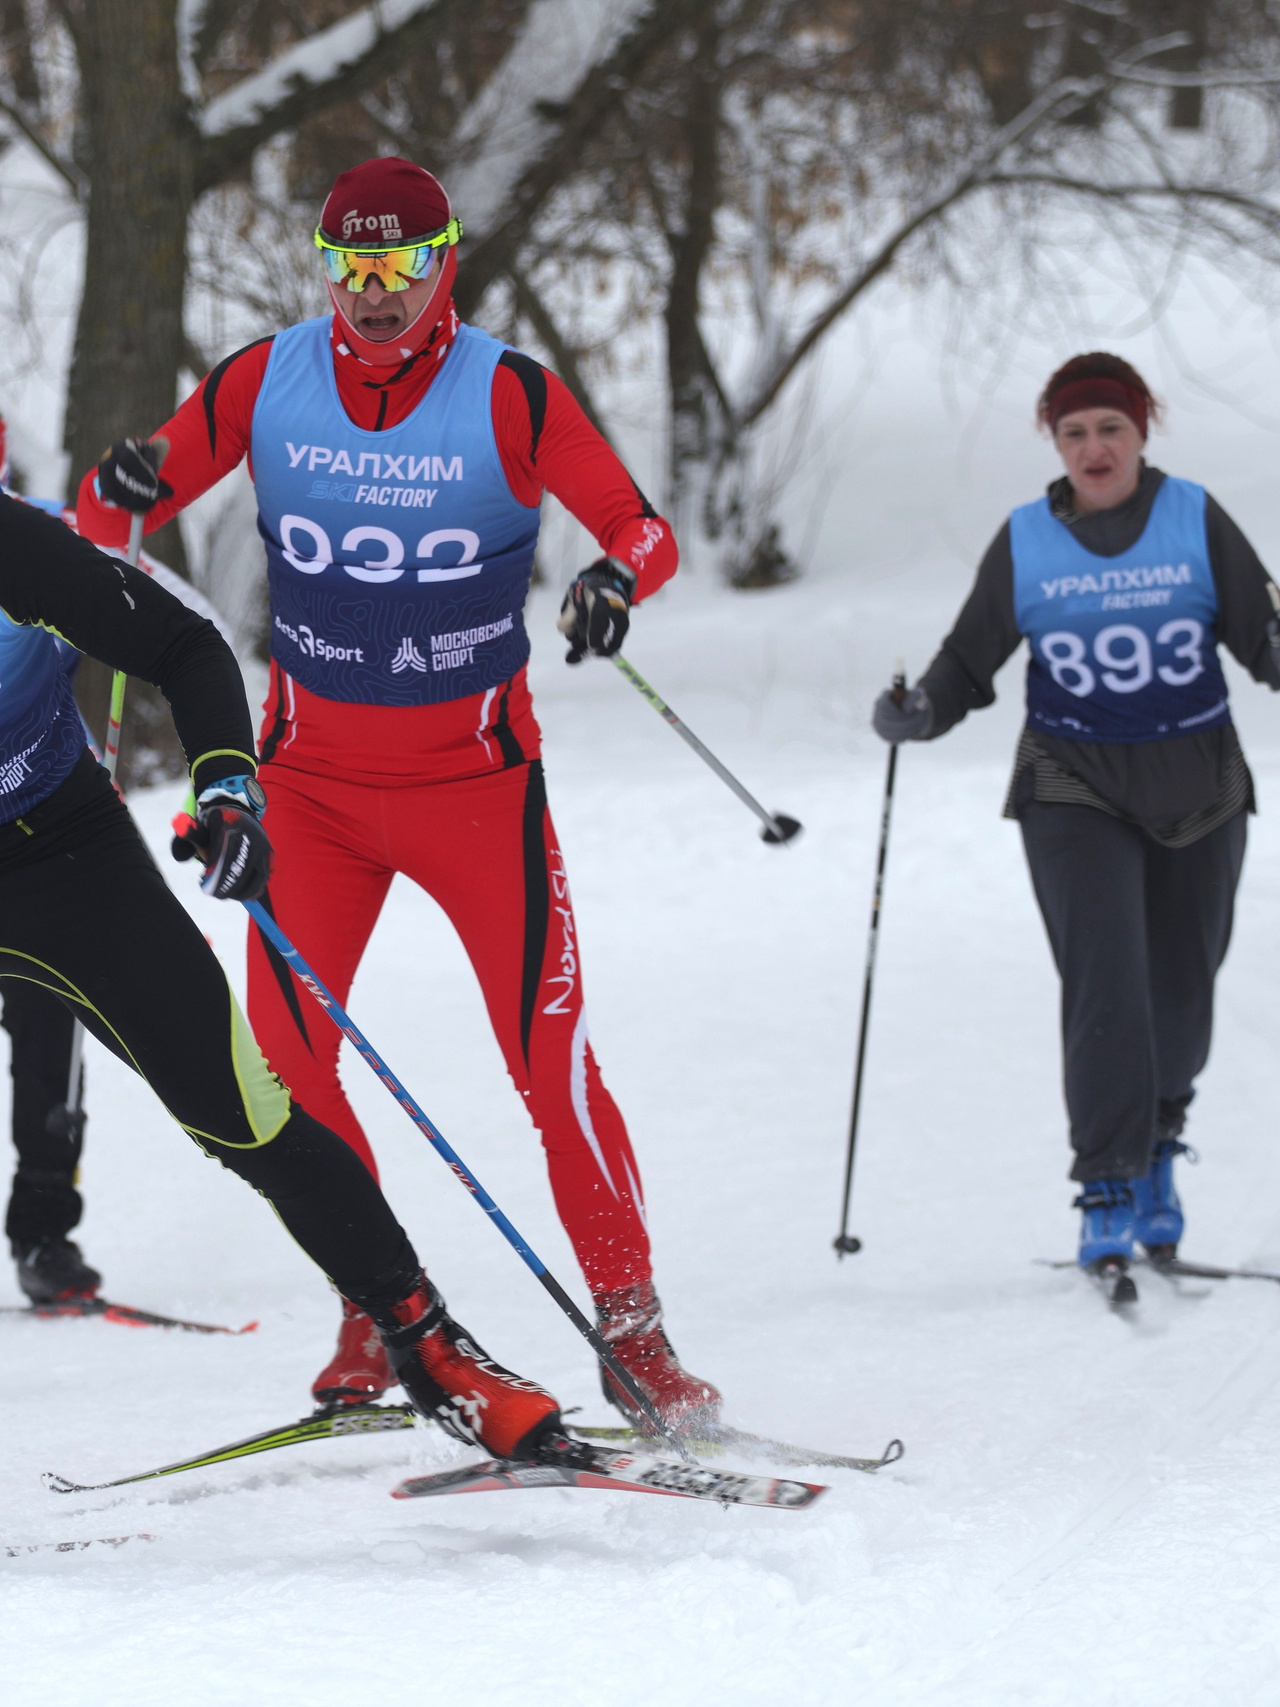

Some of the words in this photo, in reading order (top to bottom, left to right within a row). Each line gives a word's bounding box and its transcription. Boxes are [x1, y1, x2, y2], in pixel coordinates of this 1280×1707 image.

[342, 209, 400, 240] grom
[284, 441, 464, 482] УРАЛХИМ
[280, 514, 484, 584] 932
[1040, 563, 1192, 600] УРАЛХИМ
[315, 638, 365, 663] Sport
[430, 612, 514, 653] МОСКОВСКИЙ
[431, 646, 476, 672] СПОРТ
[1040, 618, 1205, 698] 893
